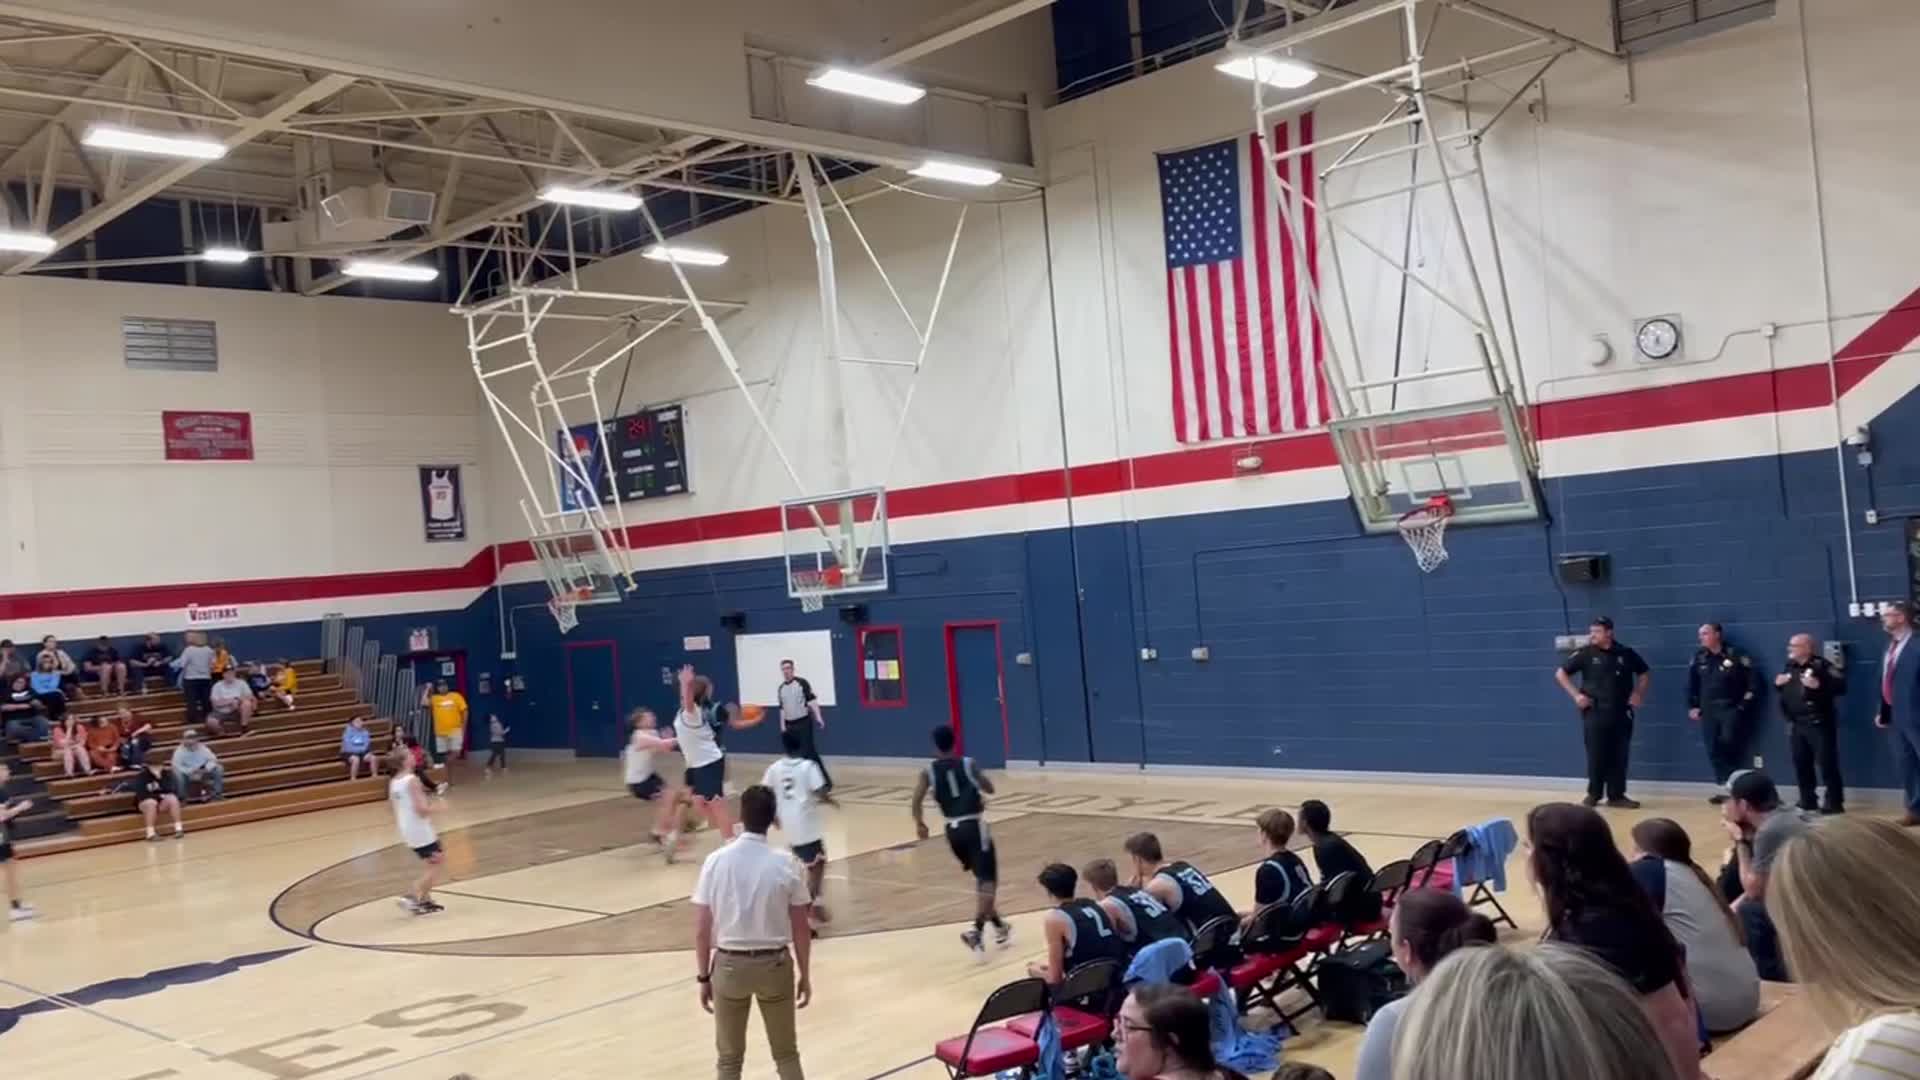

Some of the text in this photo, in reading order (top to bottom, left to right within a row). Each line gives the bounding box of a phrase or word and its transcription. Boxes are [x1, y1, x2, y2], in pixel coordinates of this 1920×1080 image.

[189, 608, 238, 621] VISITORS
[946, 768, 961, 798] 1
[1082, 907, 1112, 938] 2
[131, 994, 528, 1080] ES
